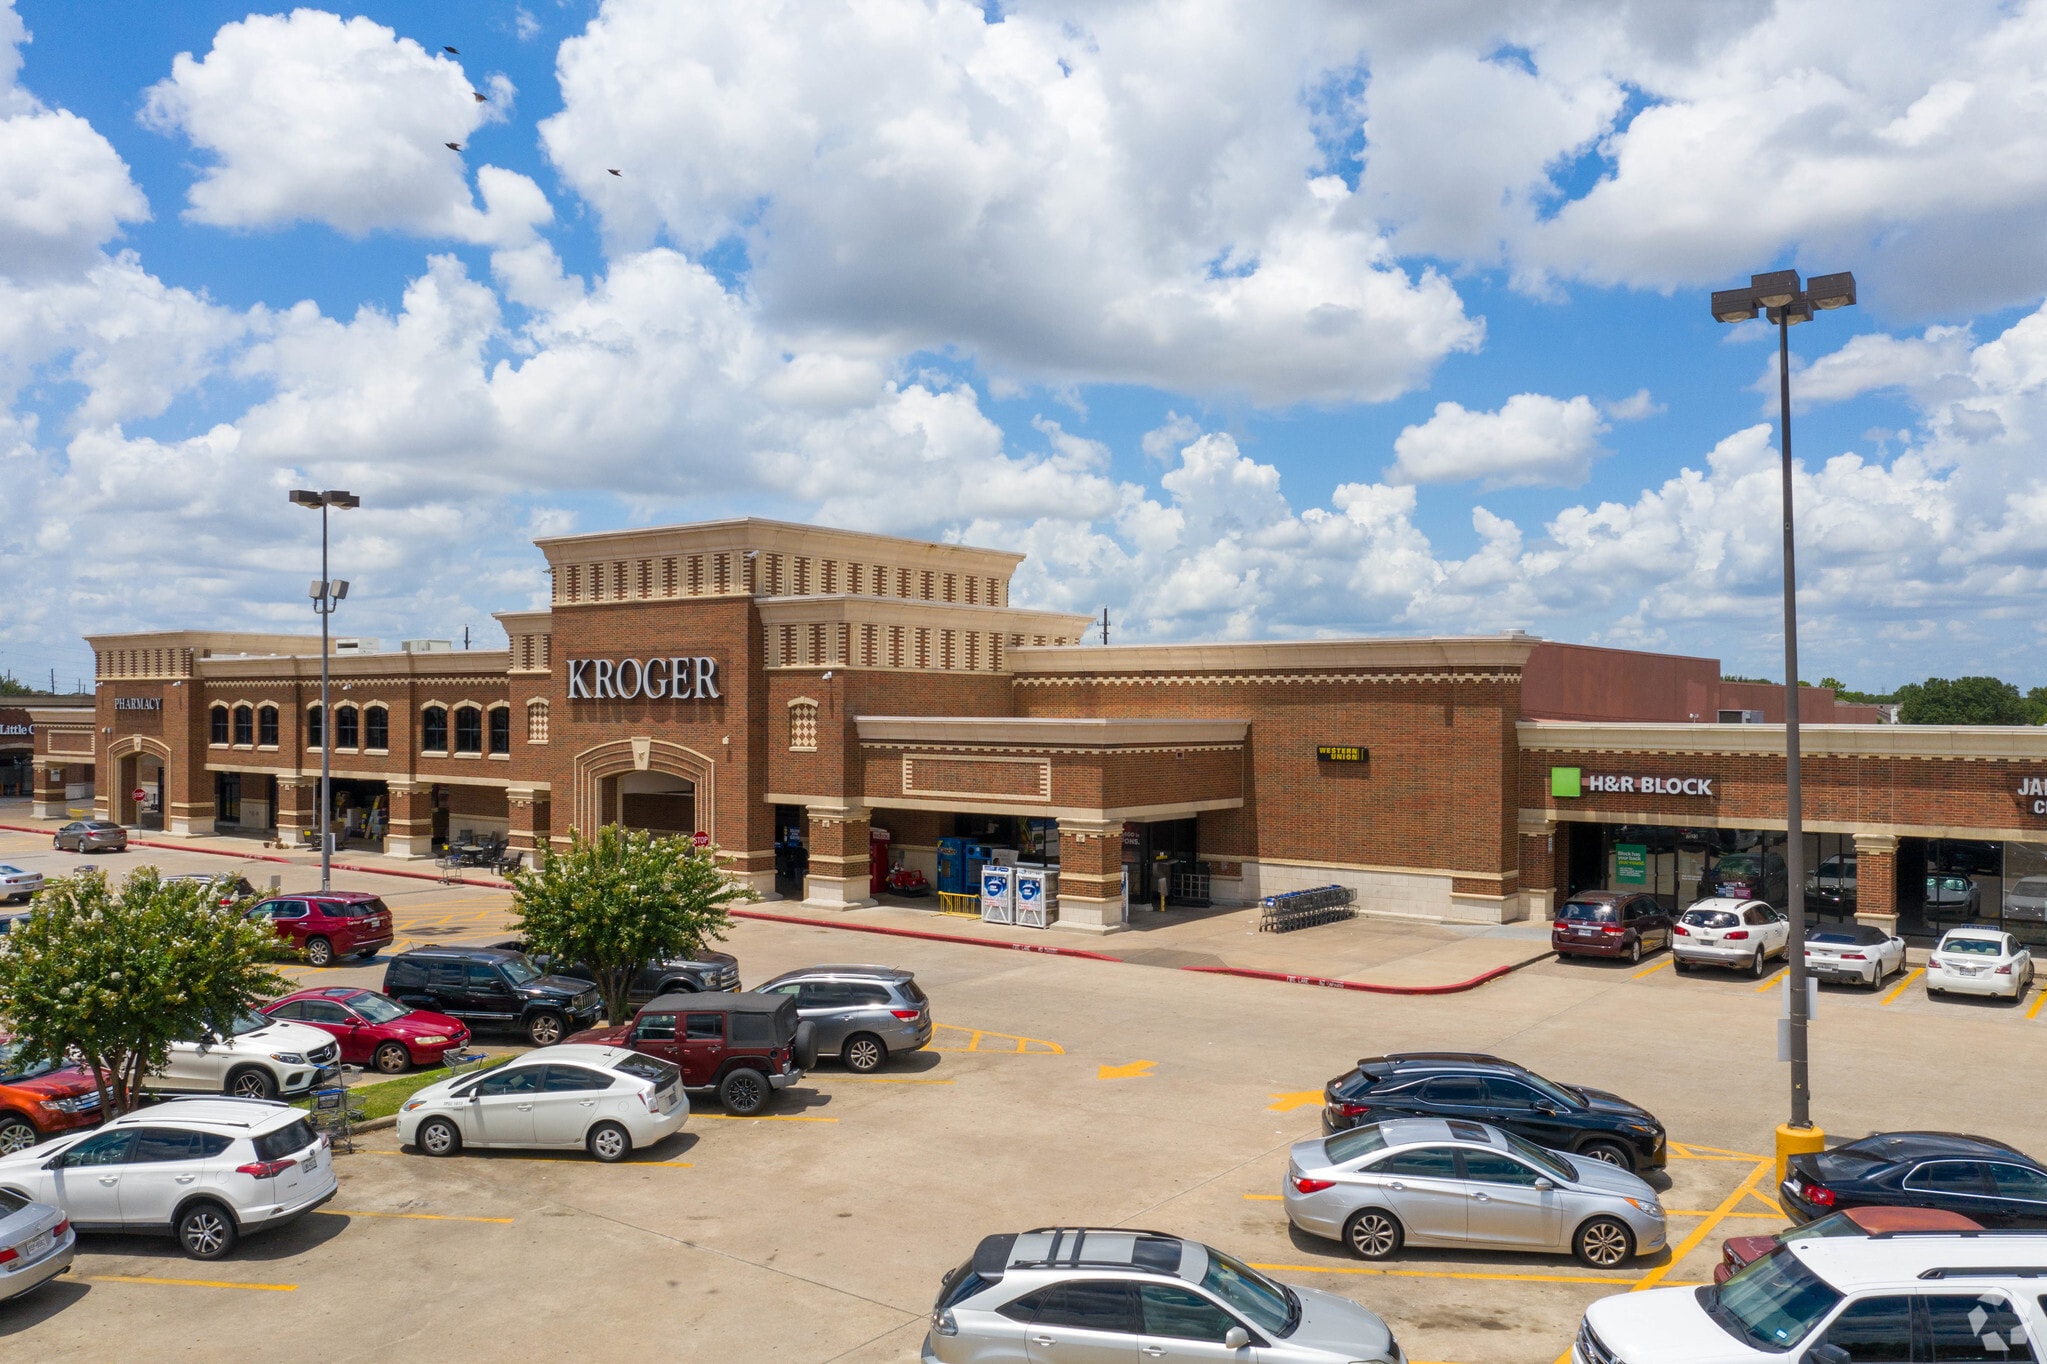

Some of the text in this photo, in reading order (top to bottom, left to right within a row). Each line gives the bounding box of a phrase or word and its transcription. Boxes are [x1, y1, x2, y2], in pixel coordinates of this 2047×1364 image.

[566, 656, 720, 699] KROGER
[114, 698, 161, 710] PHARMACY
[0, 724, 27, 735] Little
[1589, 775, 1713, 796] H&R BLOCK
[2017, 777, 2047, 796] JA
[2034, 799, 2047, 814] C
[693, 836, 709, 845] STOP
